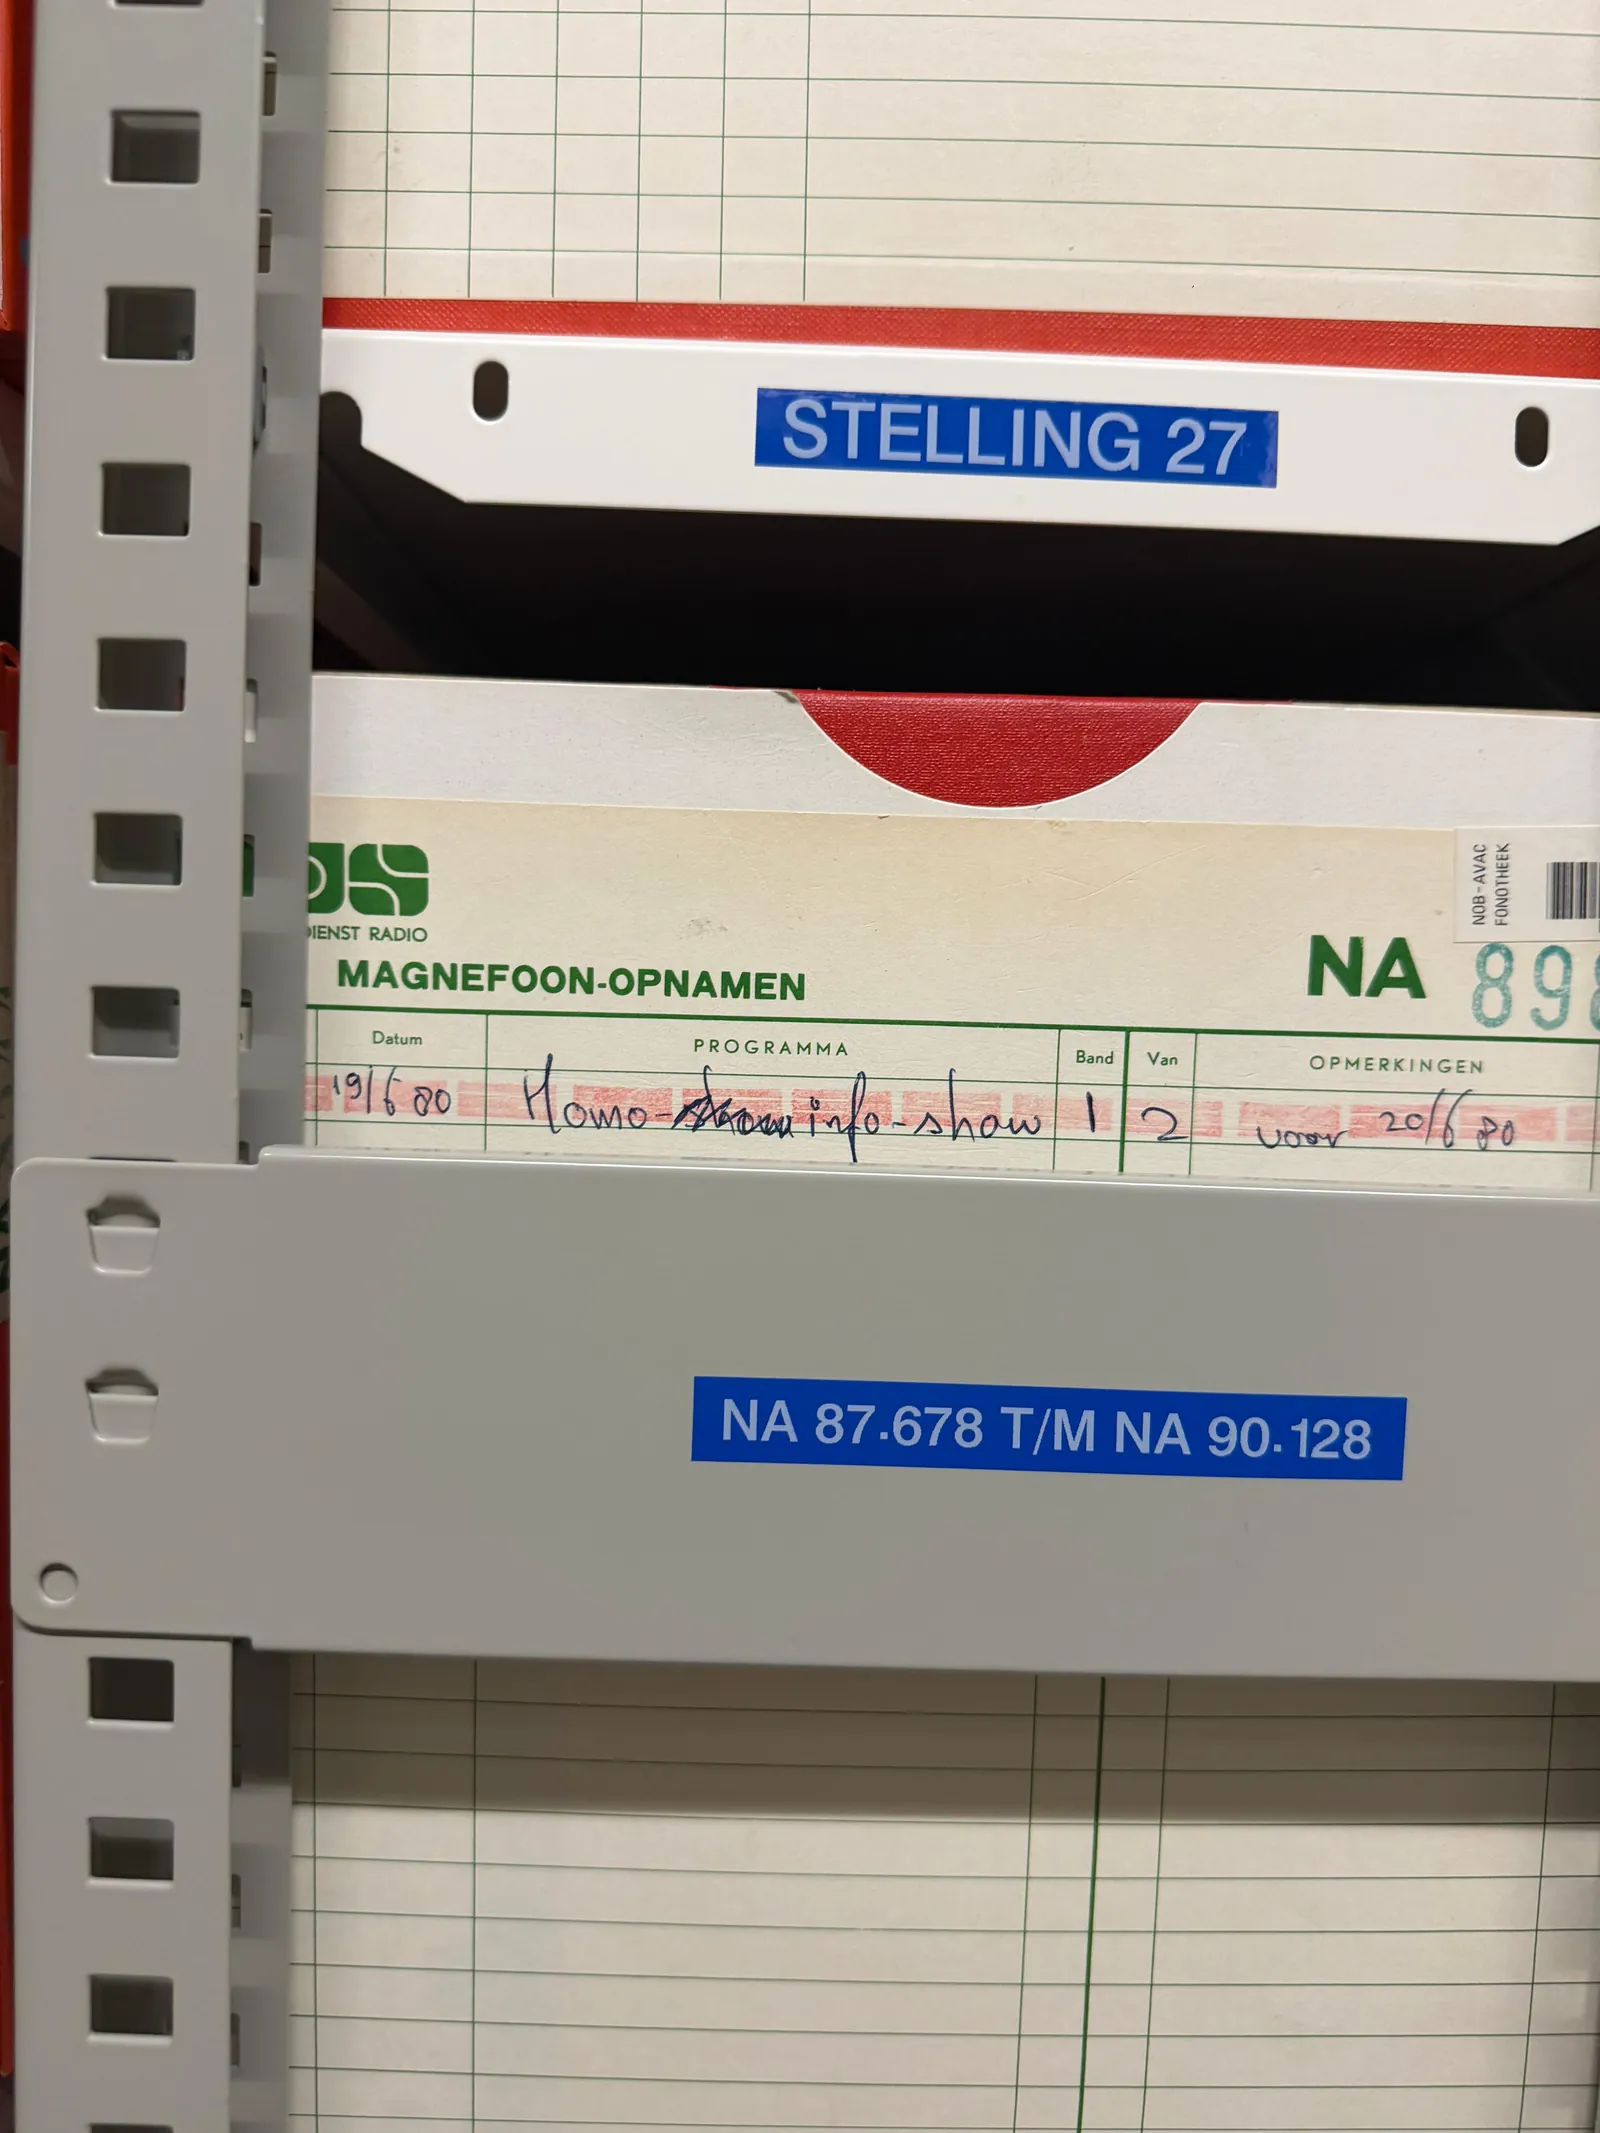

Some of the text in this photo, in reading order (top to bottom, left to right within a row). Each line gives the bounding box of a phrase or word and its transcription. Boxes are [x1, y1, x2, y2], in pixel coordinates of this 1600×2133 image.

[782, 399, 1248, 476] STELLING 27
[1472, 843, 1487, 925] NOB-AVAC
[1494, 842, 1511, 926] FONOTHEEK
[369, 926, 428, 942] RADIO
[338, 960, 806, 1001] MAGNEFOON-OPNAMEN
[1307, 935, 1600, 1032] NA 89
[372, 1031, 423, 1046] Datum
[694, 1039, 849, 1056] PROGRAMMA
[1076, 1050, 1114, 1065] Band
[1147, 1053, 1178, 1067] Van
[1310, 1055, 1484, 1074] OPMERKINGEN
[722, 1400, 1371, 1461] NA 87.678 T/M NA 90.128
